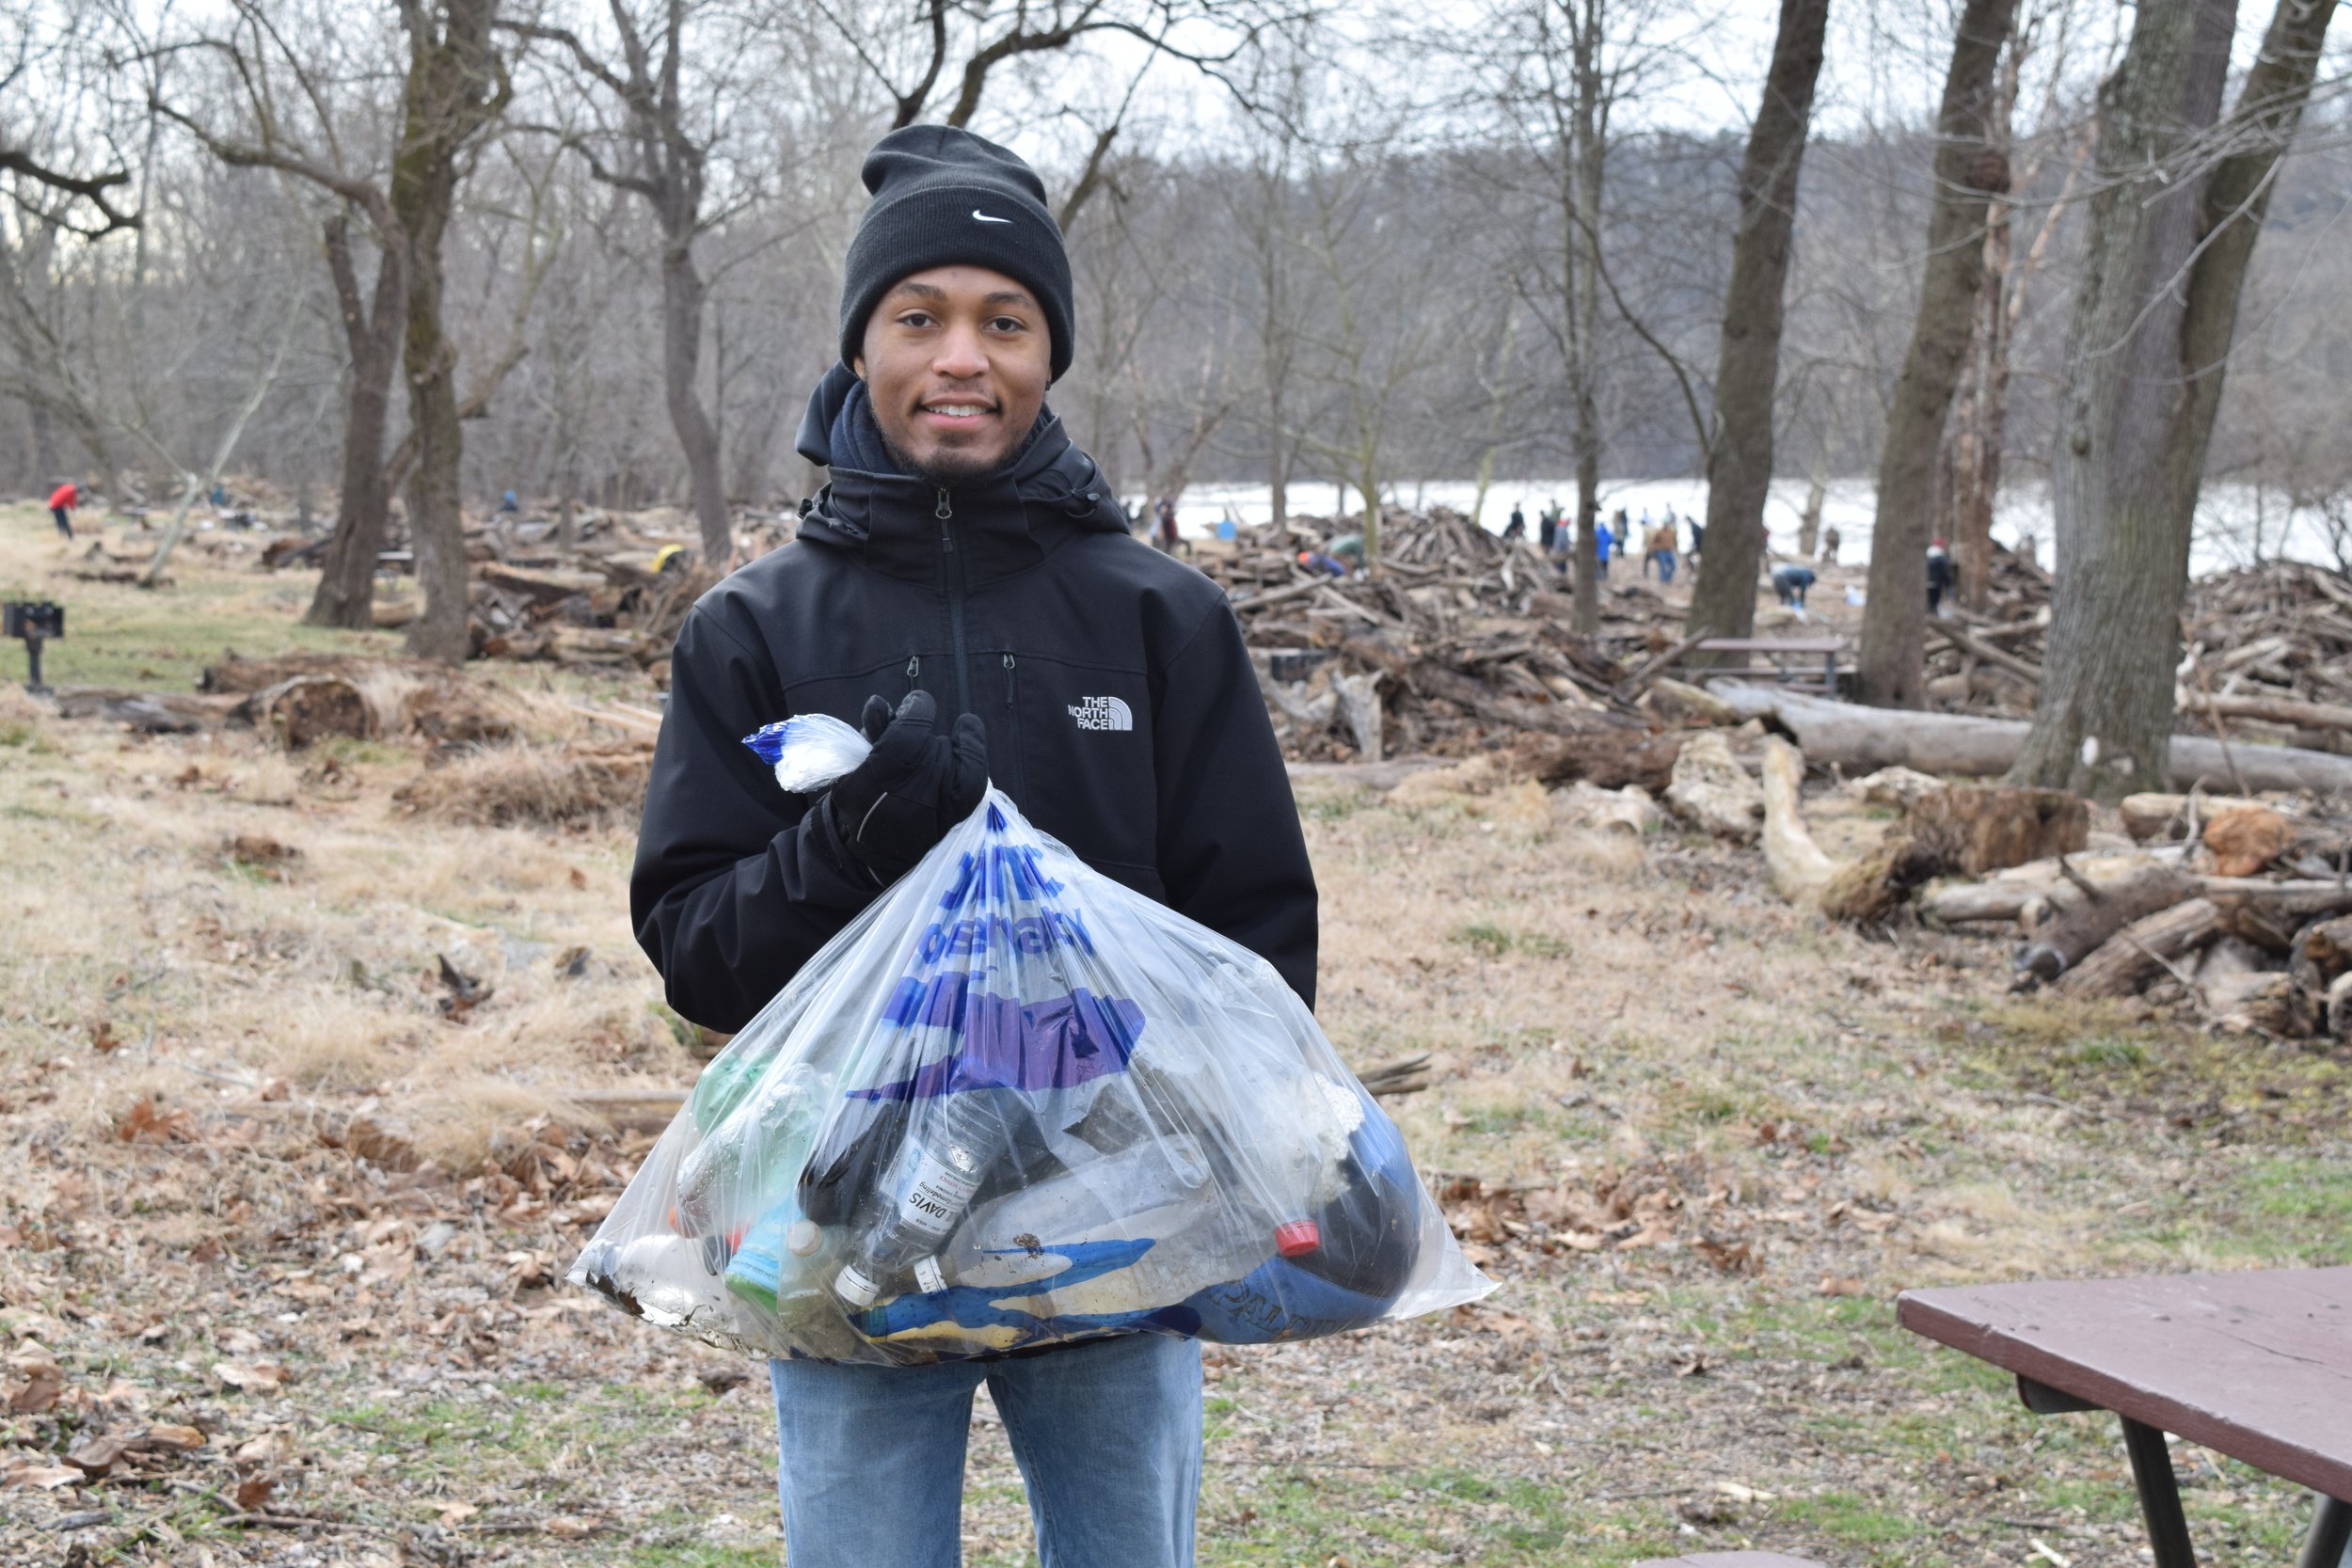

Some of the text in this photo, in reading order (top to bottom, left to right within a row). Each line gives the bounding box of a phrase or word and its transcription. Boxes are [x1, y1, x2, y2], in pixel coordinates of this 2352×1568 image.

[1082, 696, 1108, 707] THE
[1068, 705, 1108, 719] NORTH
[1077, 718, 1108, 730] FACE
[919, 1180, 952, 1205] Remodeling
[909, 1193, 947, 1219] DAVIS
